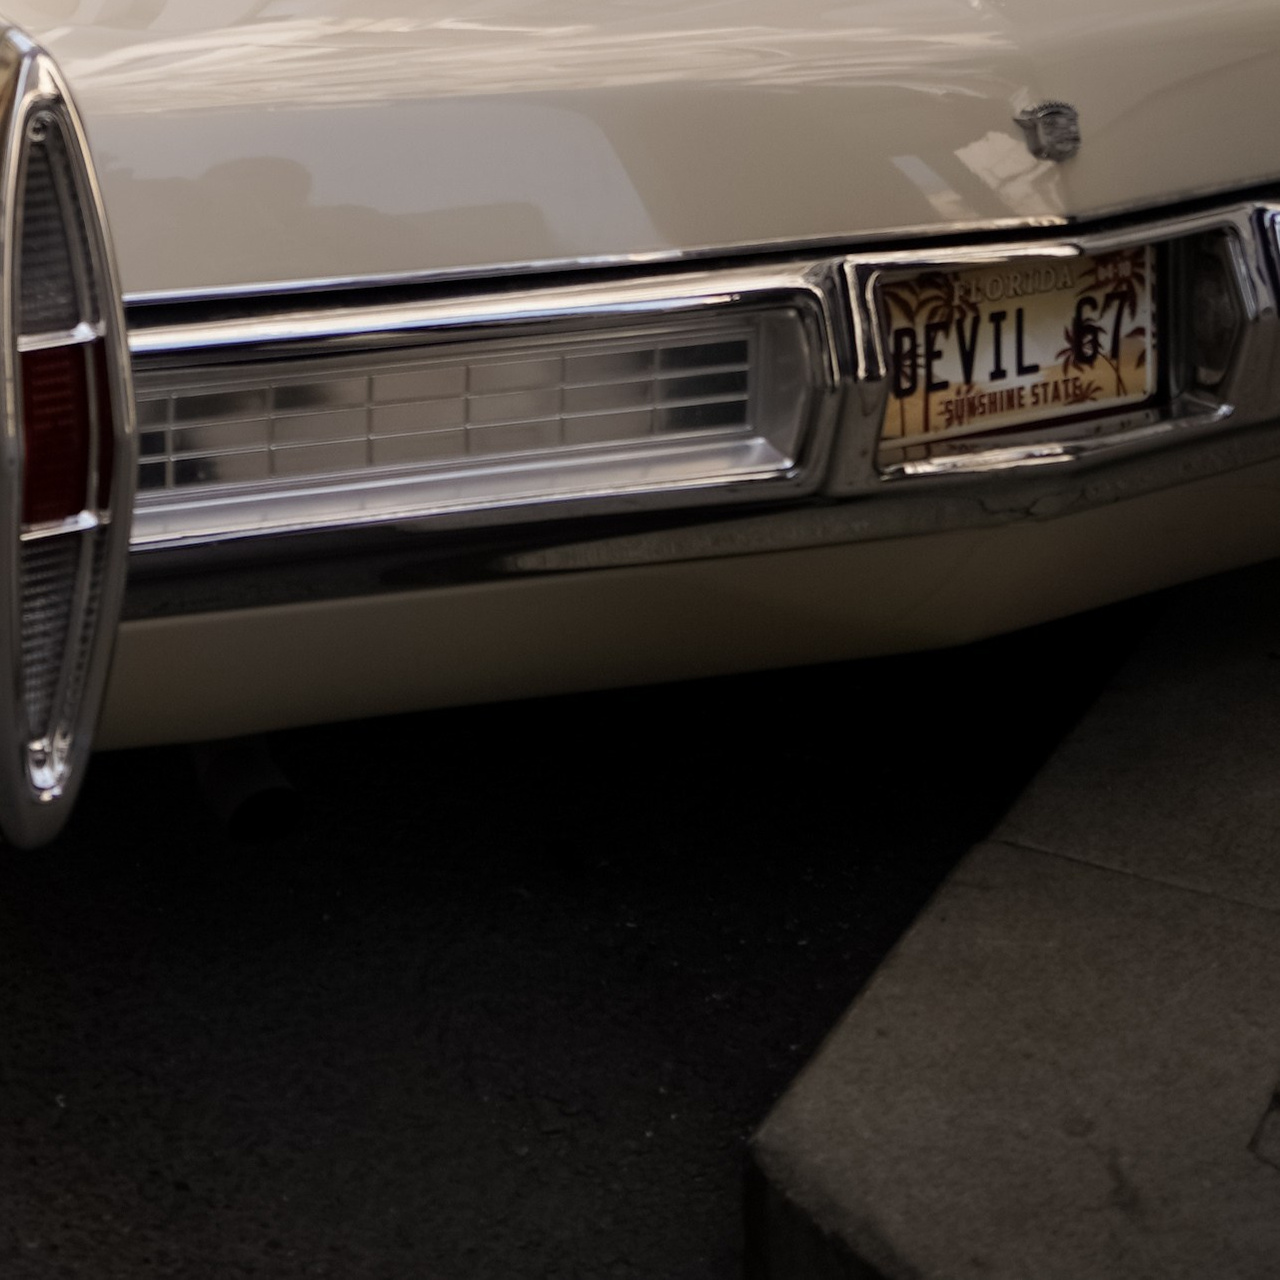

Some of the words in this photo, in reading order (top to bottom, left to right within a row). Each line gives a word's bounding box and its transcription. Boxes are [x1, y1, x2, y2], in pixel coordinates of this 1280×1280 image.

[952, 265, 1073, 303] FLORIDA
[893, 307, 1040, 399] DEVIL
[1073, 292, 1127, 363] 67
[944, 386, 1026, 426] SUNSHINE
[1030, 377, 1083, 407] STATE
